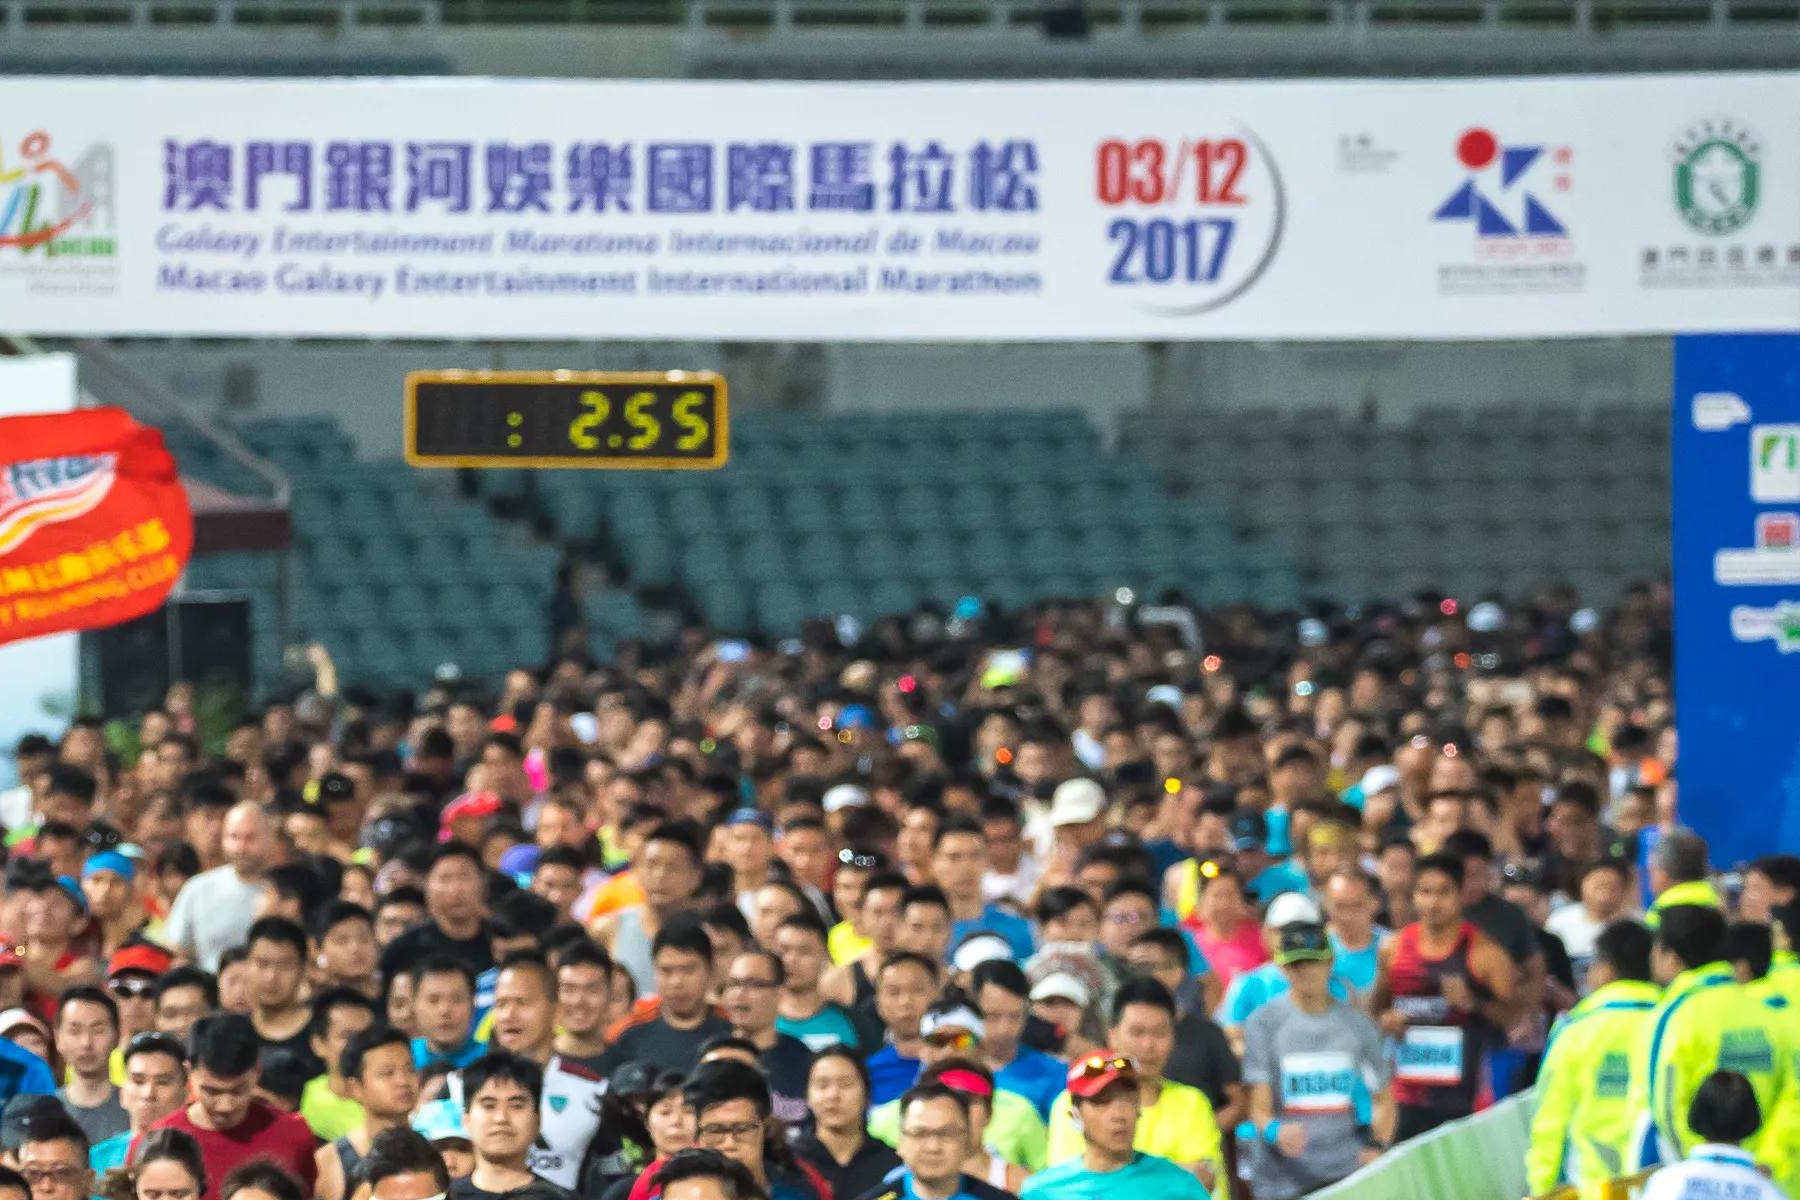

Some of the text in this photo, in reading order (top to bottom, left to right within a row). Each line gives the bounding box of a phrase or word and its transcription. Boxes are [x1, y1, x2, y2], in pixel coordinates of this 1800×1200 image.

[163, 138, 1040, 212] 澳門銀河娛樂國際馬拉松
[1097, 138, 1247, 204] 03/12
[1108, 216, 1236, 282] 2017
